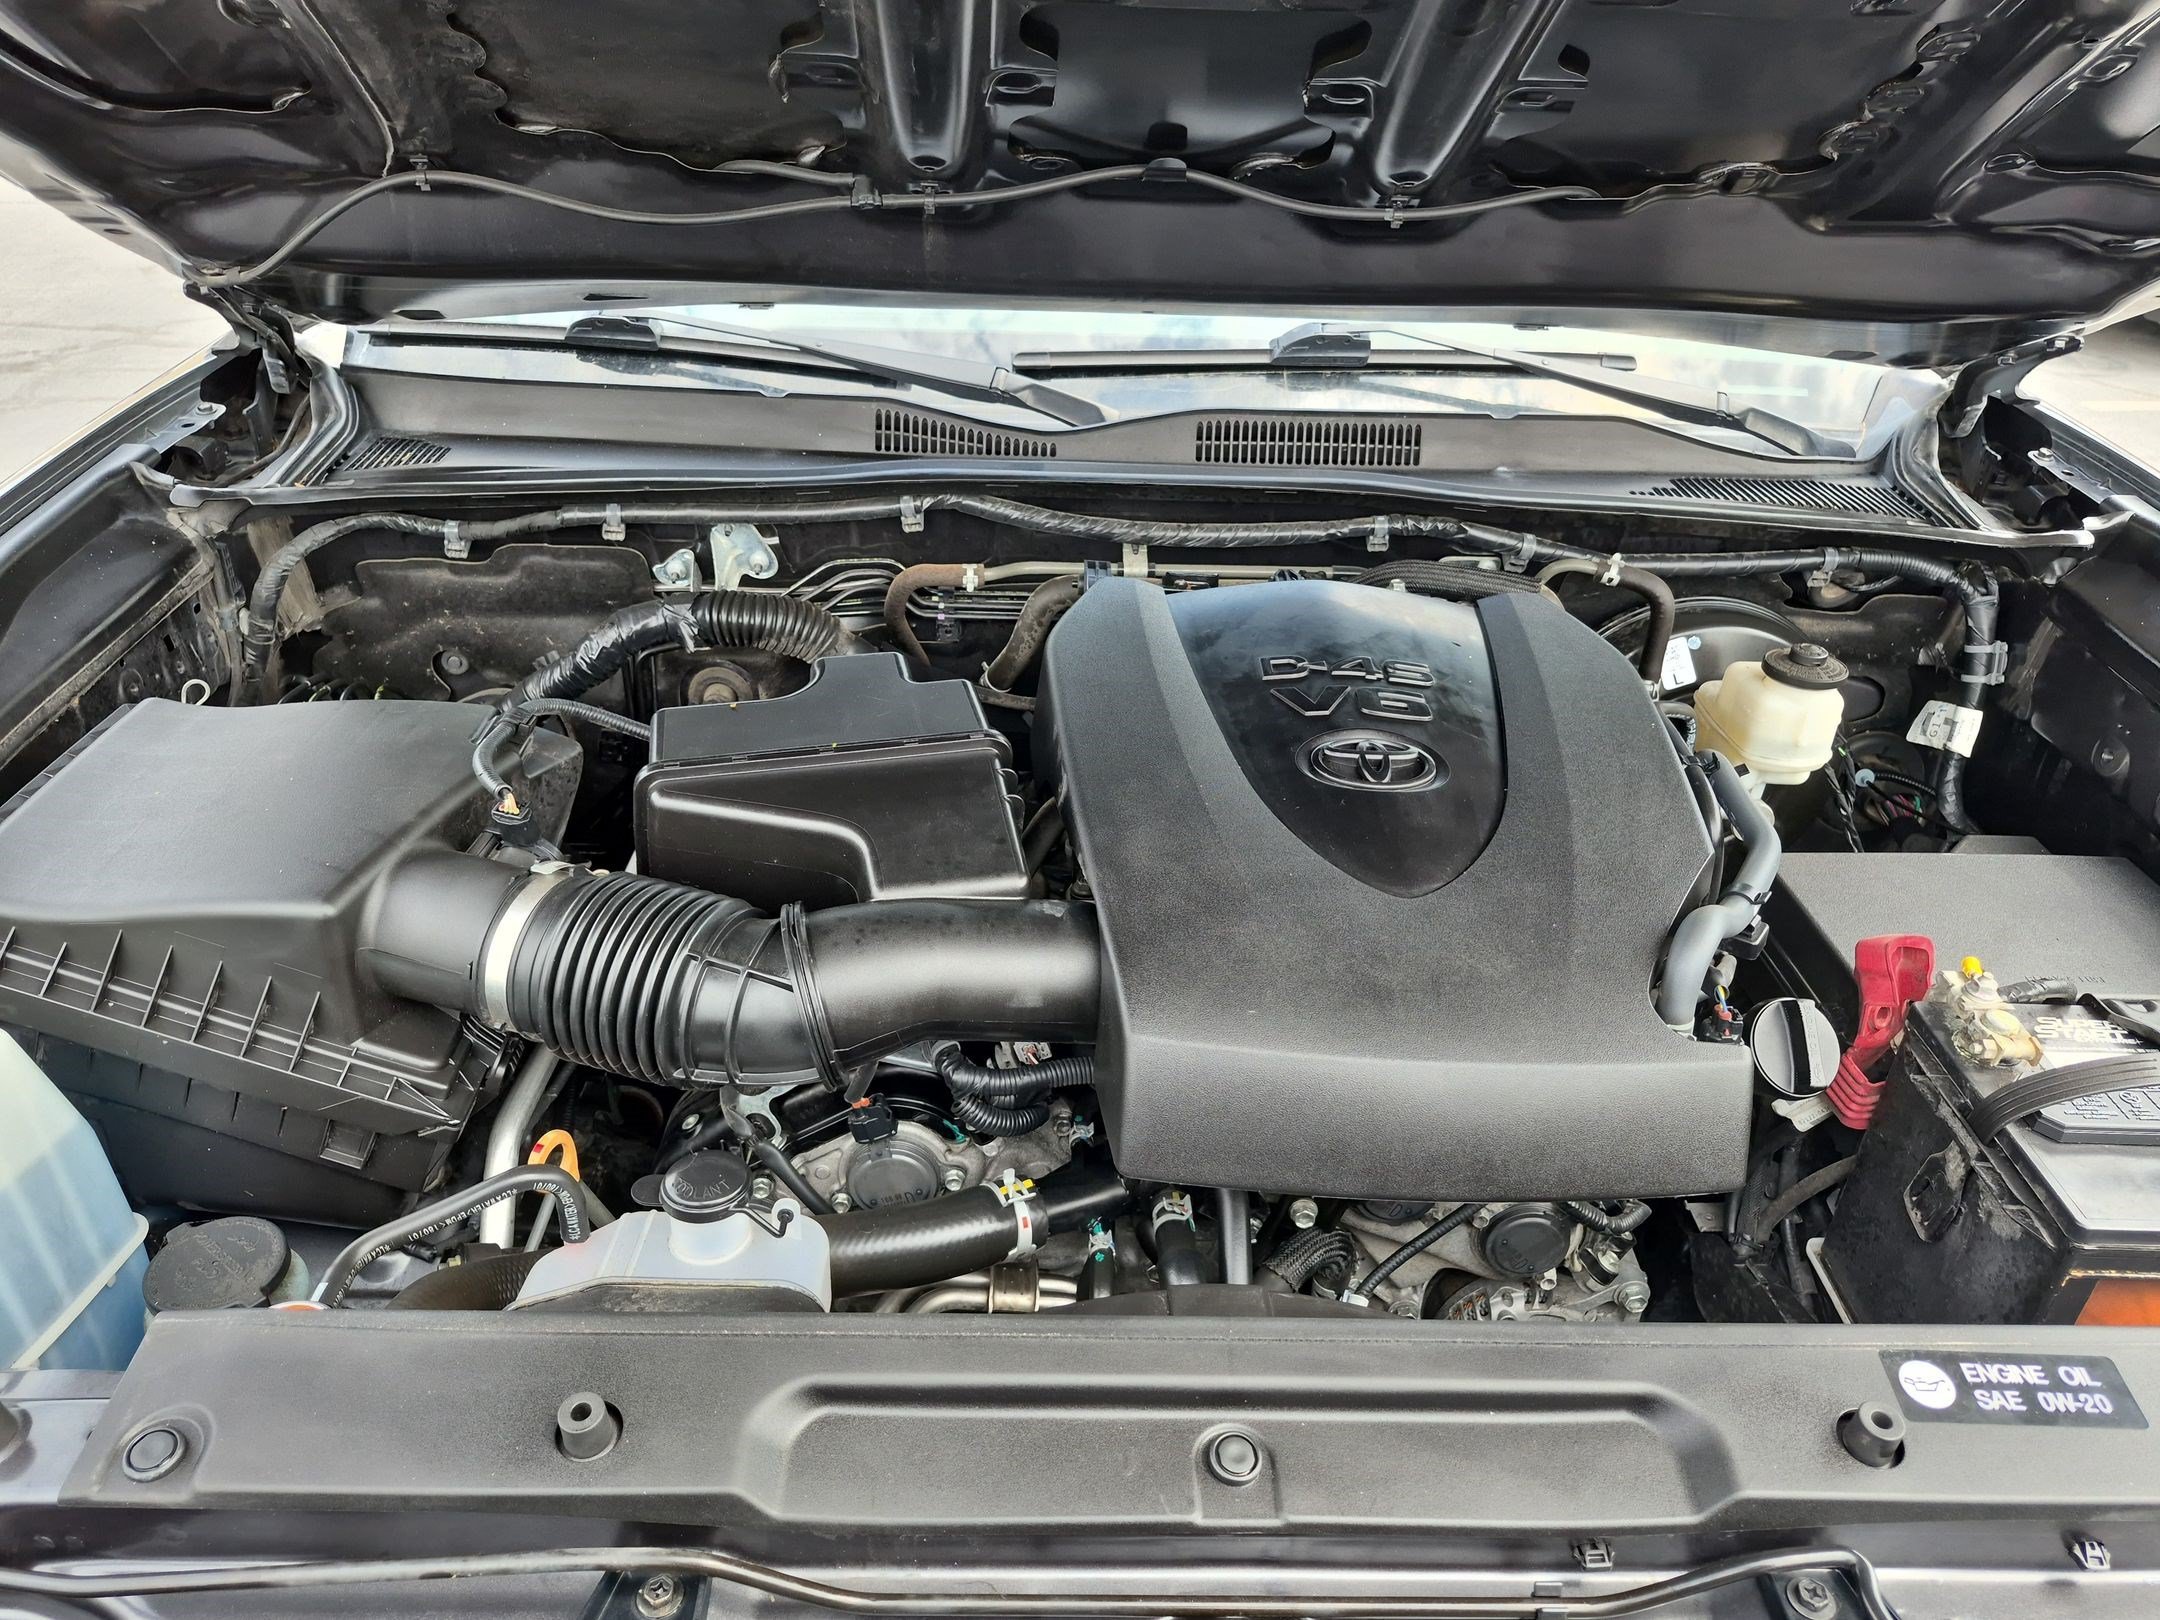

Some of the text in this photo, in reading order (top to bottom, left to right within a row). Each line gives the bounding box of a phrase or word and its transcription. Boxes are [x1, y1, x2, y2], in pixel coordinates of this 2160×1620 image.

[1258, 655, 1435, 687] D-4S
[1269, 685, 1434, 722] V6
[1958, 1362, 2102, 1387] ENGINE OIL
[1973, 1390, 2114, 1415] SAE 0W-20
